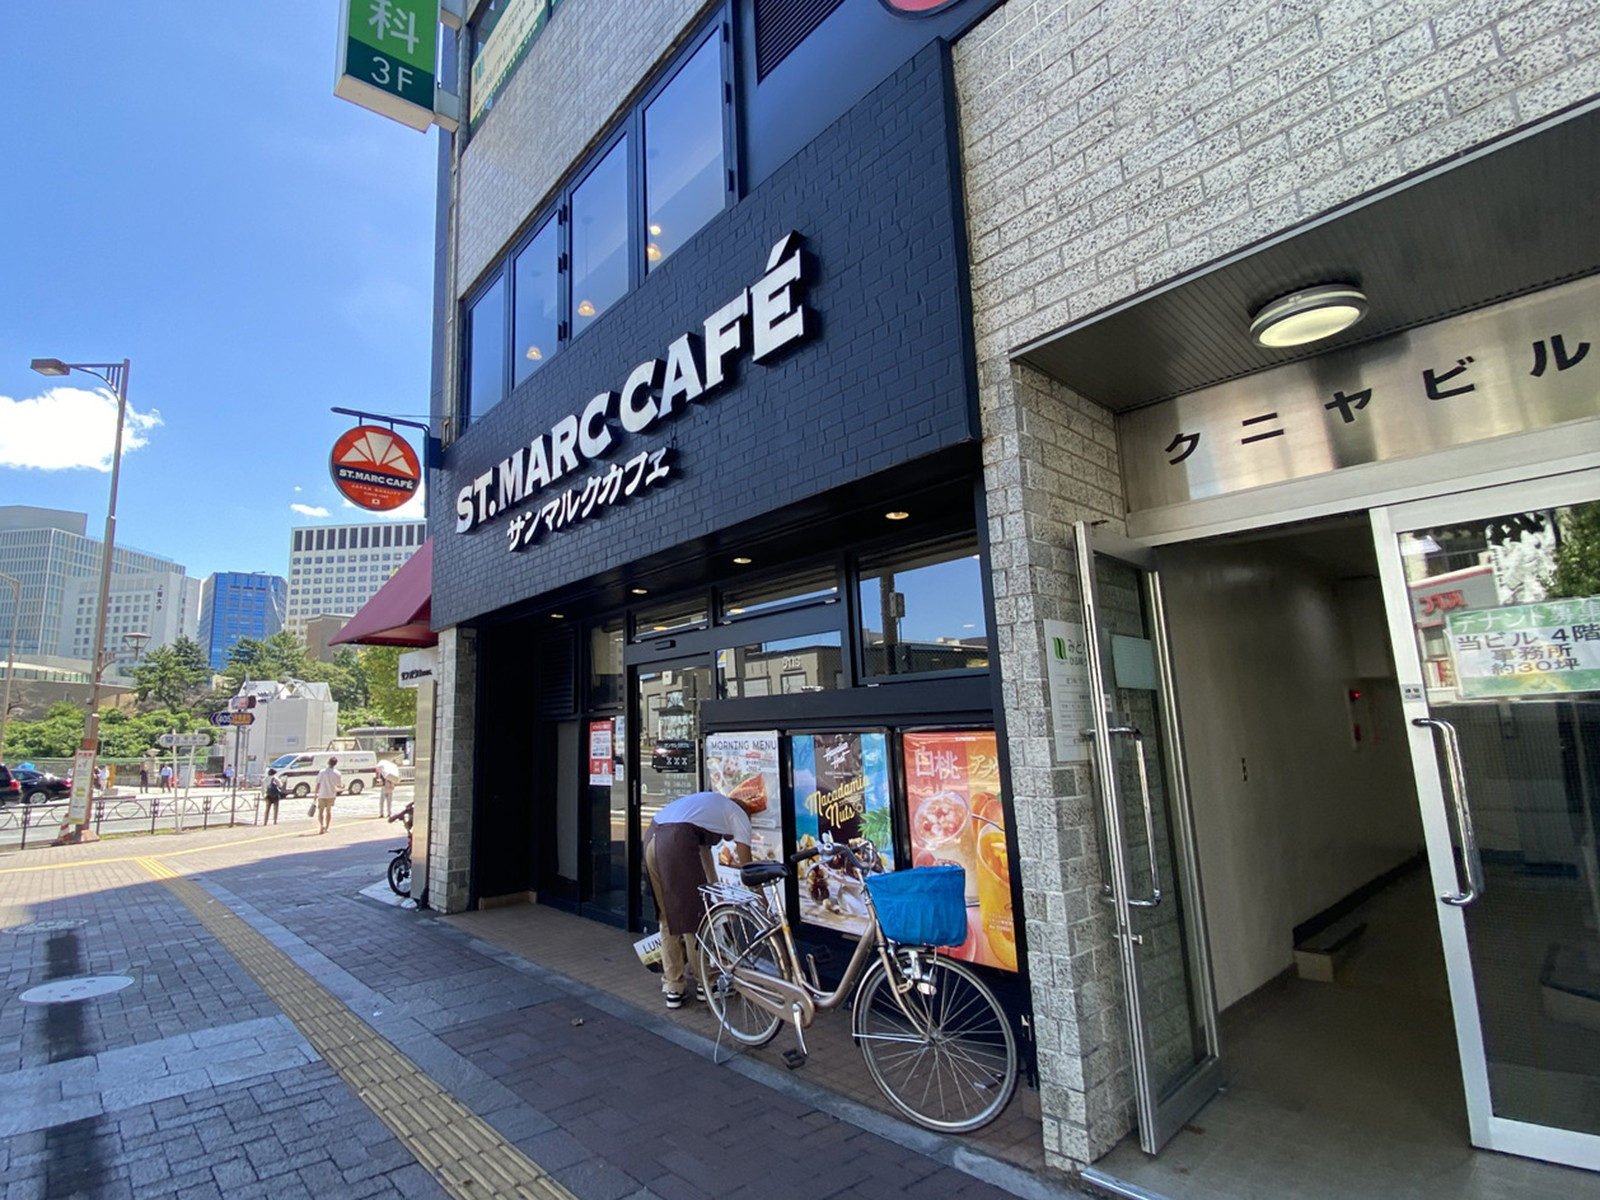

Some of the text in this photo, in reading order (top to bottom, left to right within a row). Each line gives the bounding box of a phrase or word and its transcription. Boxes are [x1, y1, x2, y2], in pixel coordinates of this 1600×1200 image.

[368, 0, 419, 54] 科
[371, 56, 414, 91] 3F
[456, 230, 804, 534] ST.MARC CAFÉ
[339, 468, 413, 490] ST.MARC CAFÉ
[507, 447, 671, 551] サンマルクカフェ
[1491, 643, 1572, 662] 事務所
[711, 740, 777, 750] MORNING MENU
[915, 746, 961, 780] 白桃
[825, 802, 855, 829] Nuts
